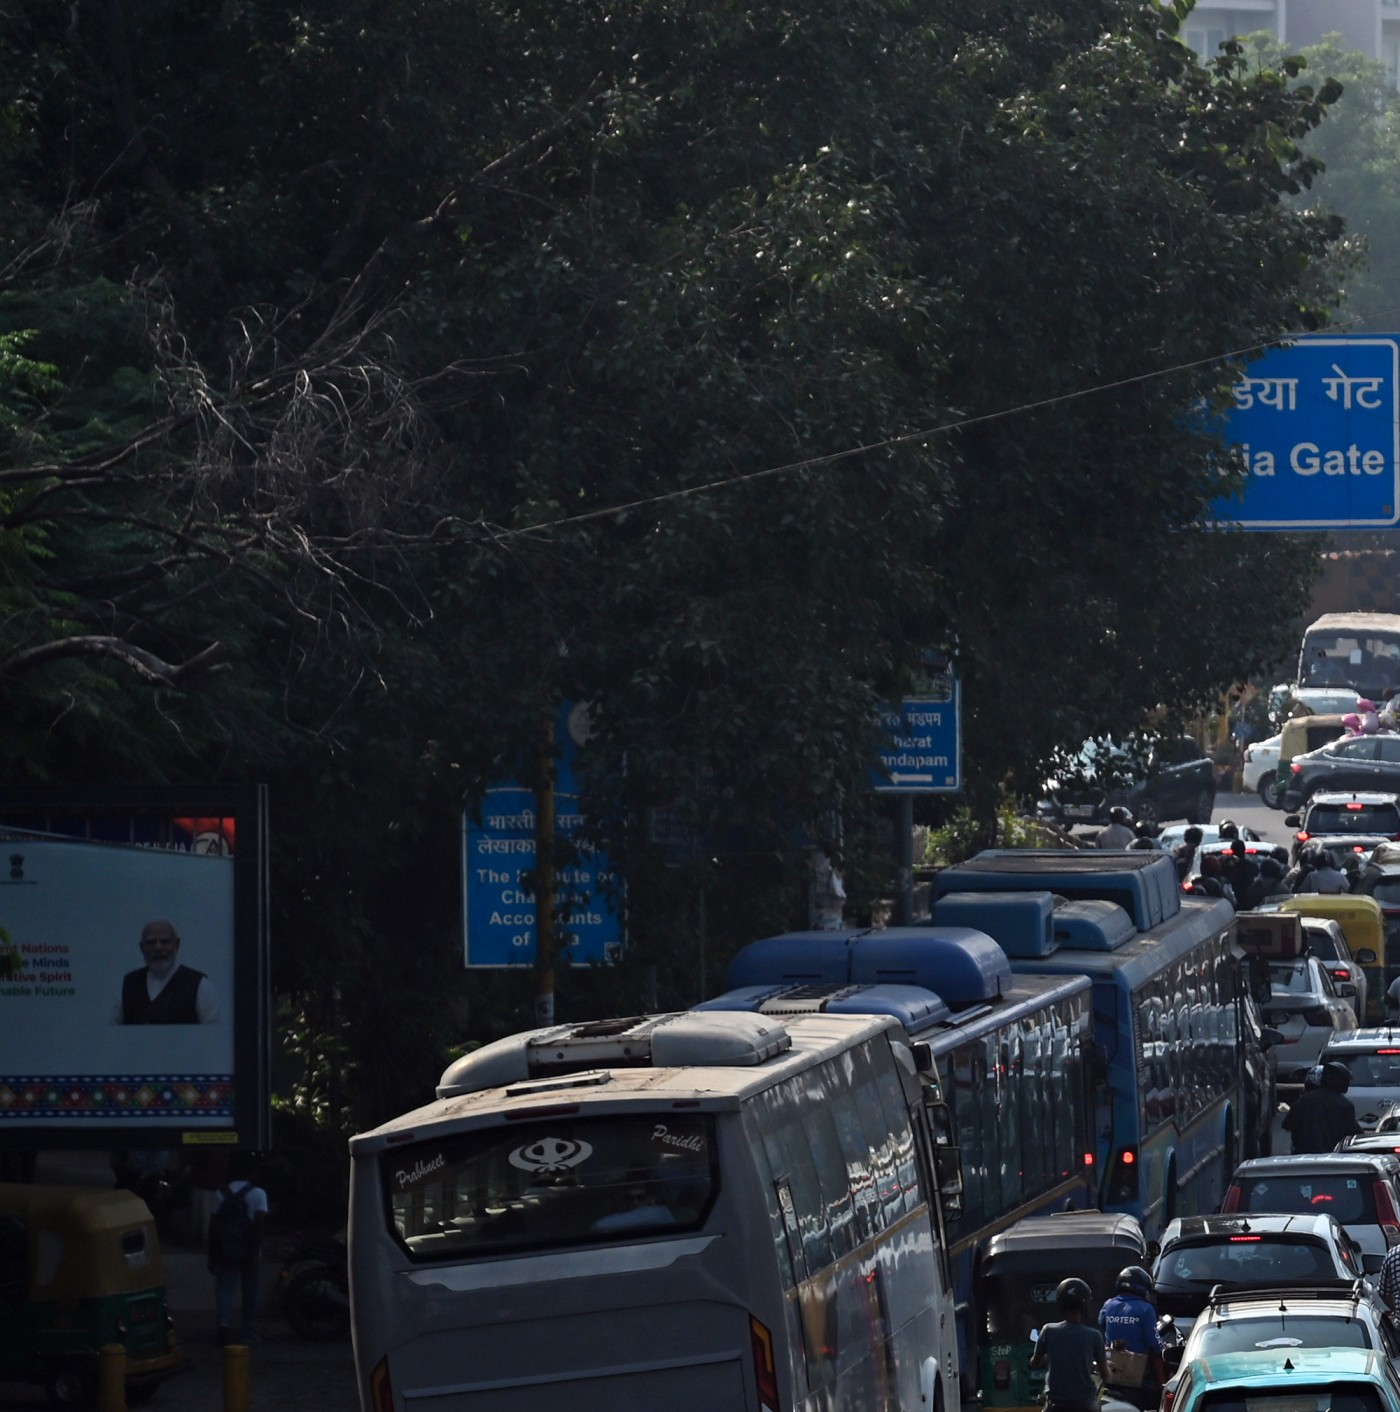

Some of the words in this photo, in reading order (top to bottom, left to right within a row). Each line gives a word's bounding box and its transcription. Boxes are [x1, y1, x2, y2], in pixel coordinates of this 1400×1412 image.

[1322, 363, 1383, 410] गेट
[1290, 443, 1385, 476] Gate
[894, 734, 932, 748] harat
[880, 753, 948, 770] andapam
[487, 809, 536, 830] भारती
[477, 868, 510, 884] The
[512, 931, 530, 946] of
[21, 942, 69, 954] Nations
[33, 957, 69, 968] Minds
[40, 970, 72, 983] Spirit
[35, 985, 76, 996] Future
[650, 1124, 704, 1152] Paridhi
[395, 1153, 445, 1188] Prabhneet
